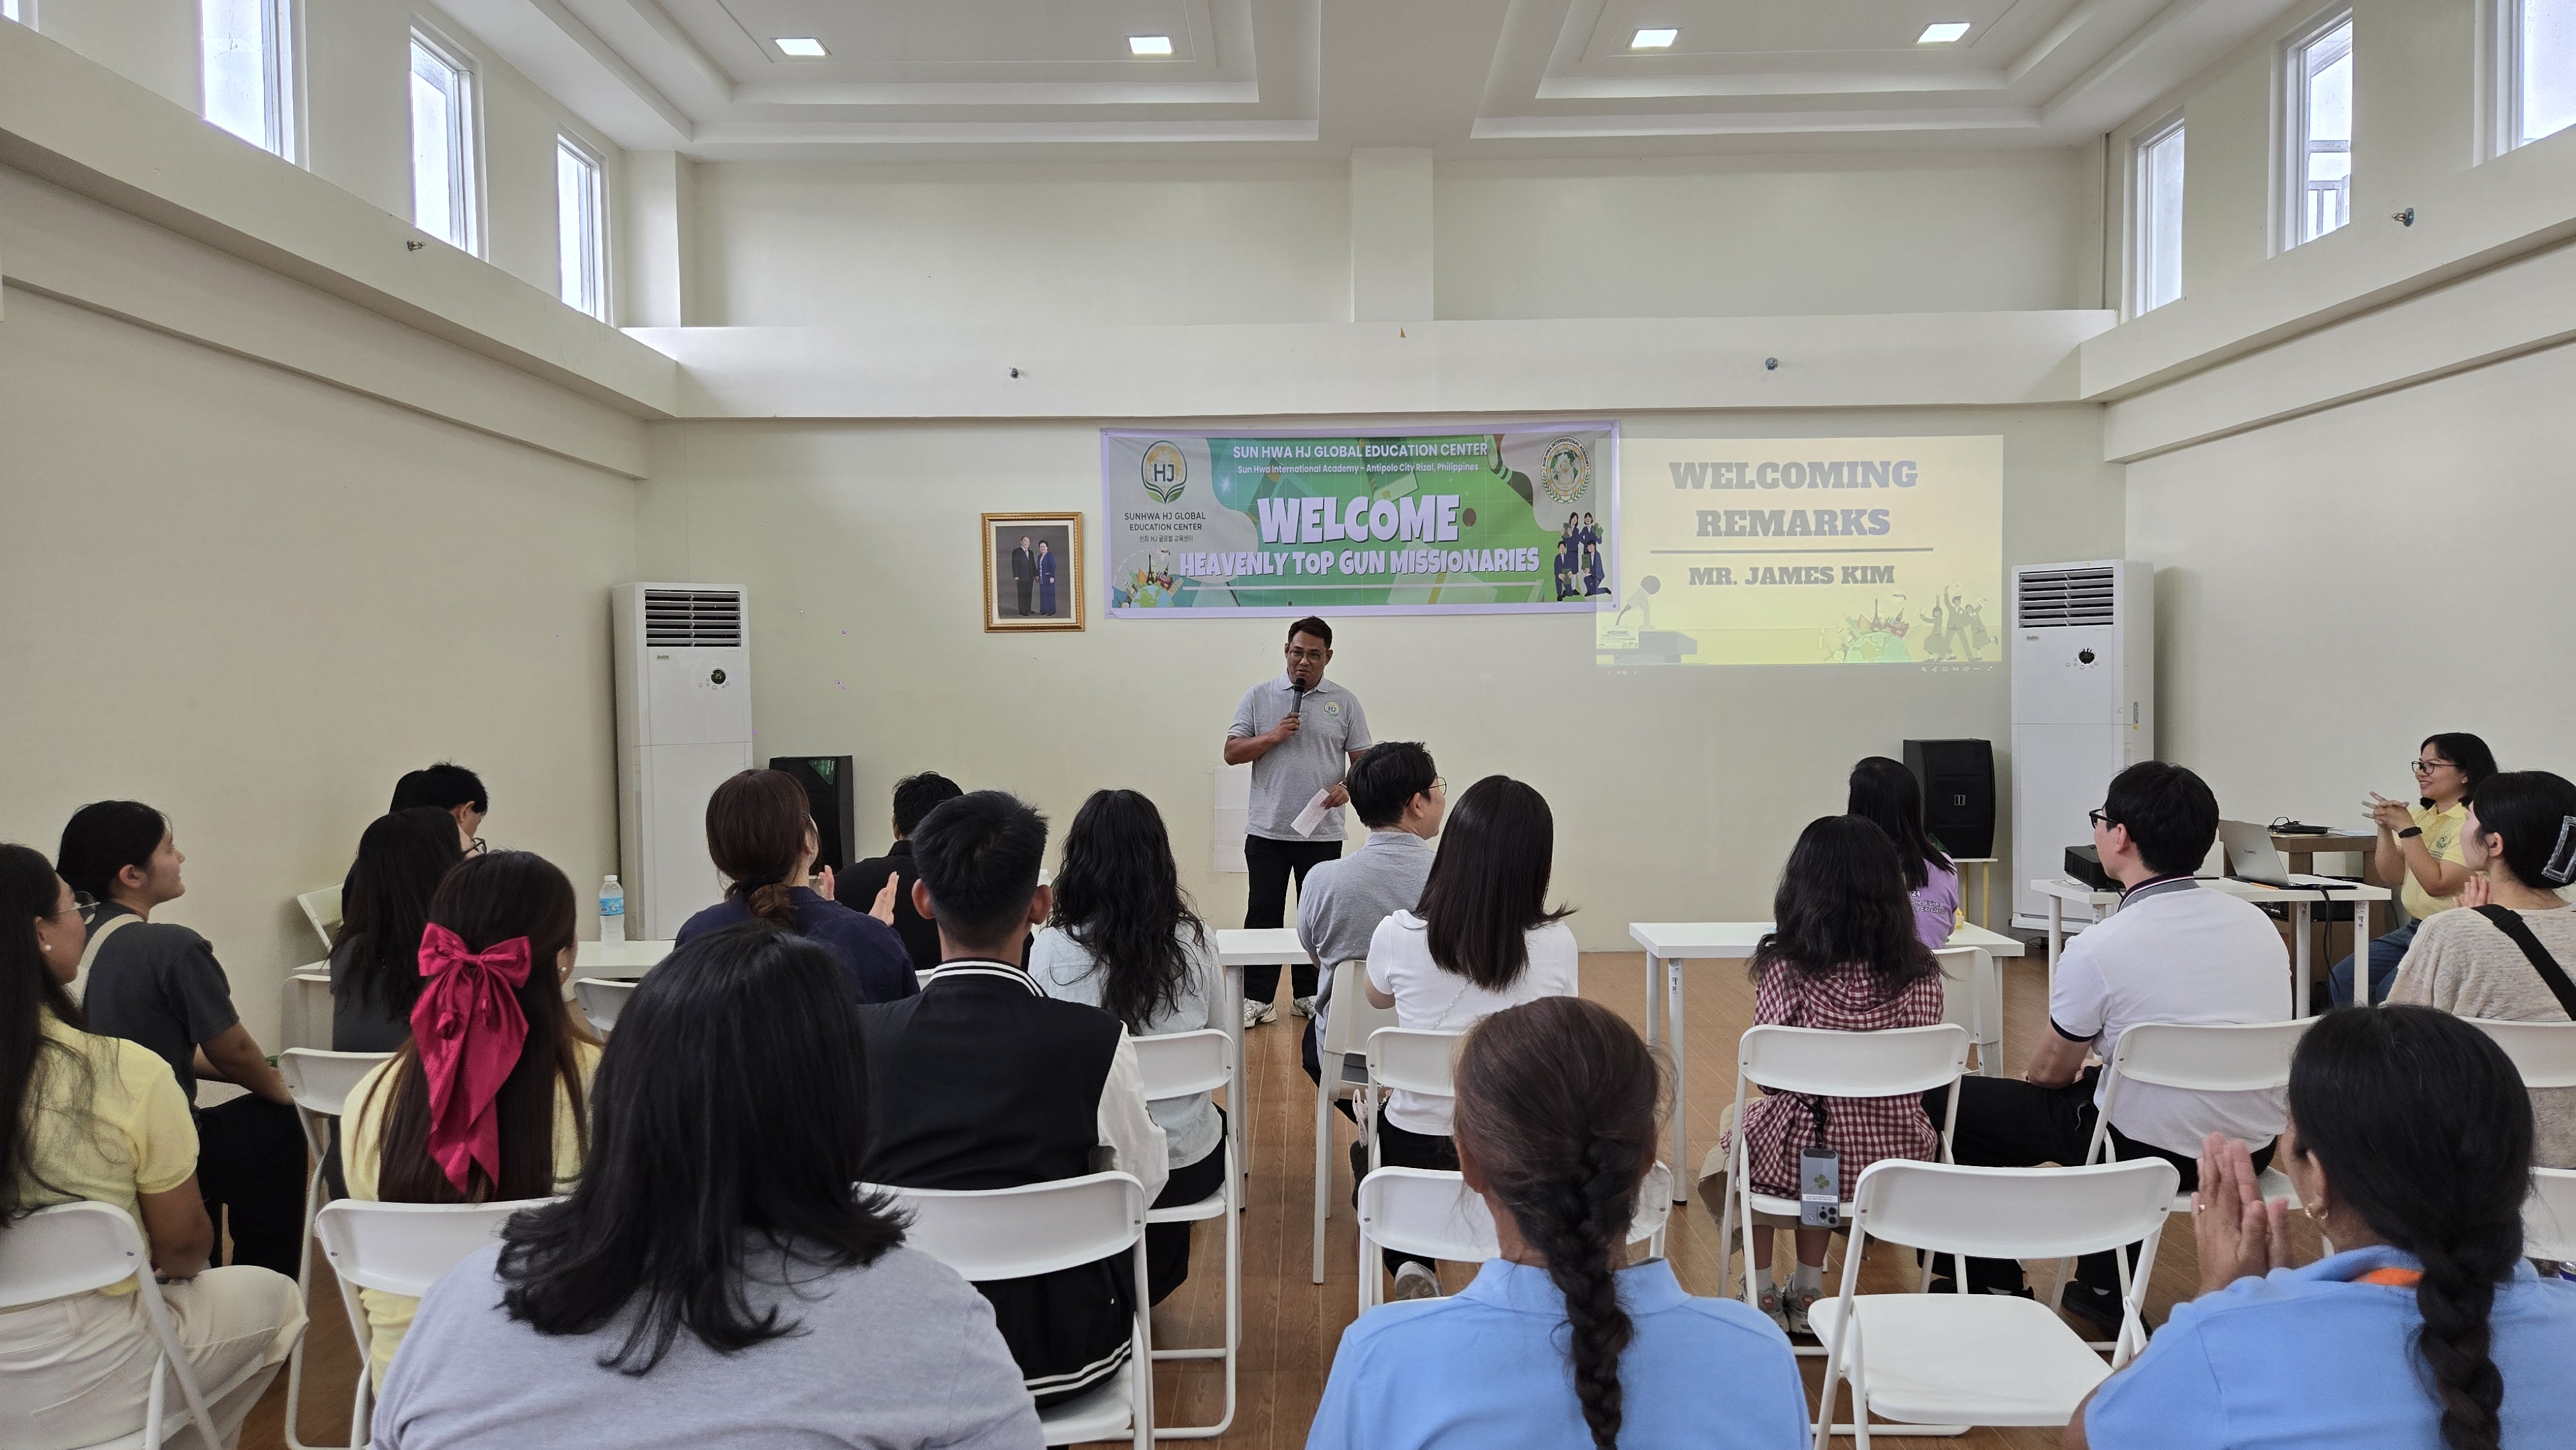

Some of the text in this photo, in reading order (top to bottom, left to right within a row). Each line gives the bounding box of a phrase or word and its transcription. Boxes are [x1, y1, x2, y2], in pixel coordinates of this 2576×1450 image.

[1233, 443, 1488, 458] SUN HWA HJ GLOBAL EDUCATION CENTER
[1551, 438, 1580, 447] INTERNATIONAL
[1579, 446, 1589, 467] ACADEMY
[1153, 463, 1175, 482] HJ
[1238, 465, 1252, 474] Sun
[1253, 465, 1271, 473] Hwa
[1272, 464, 1321, 473] International
[1322, 464, 1359, 475] Academy
[1366, 464, 1397, 474] Antipolo
[1399, 464, 1414, 475] City
[1416, 463, 1435, 473] Rizal,
[1437, 462, 1479, 474] Philippines
[1669, 460, 1918, 489] WELCOMING
[1256, 494, 1461, 544] WELCOME
[1696, 509, 1891, 537] REMARKS
[1180, 547, 1540, 576] HEAVENLY TOP GUN MISSIONARIES
[1689, 565, 1895, 585] MR. JAMES KIM
